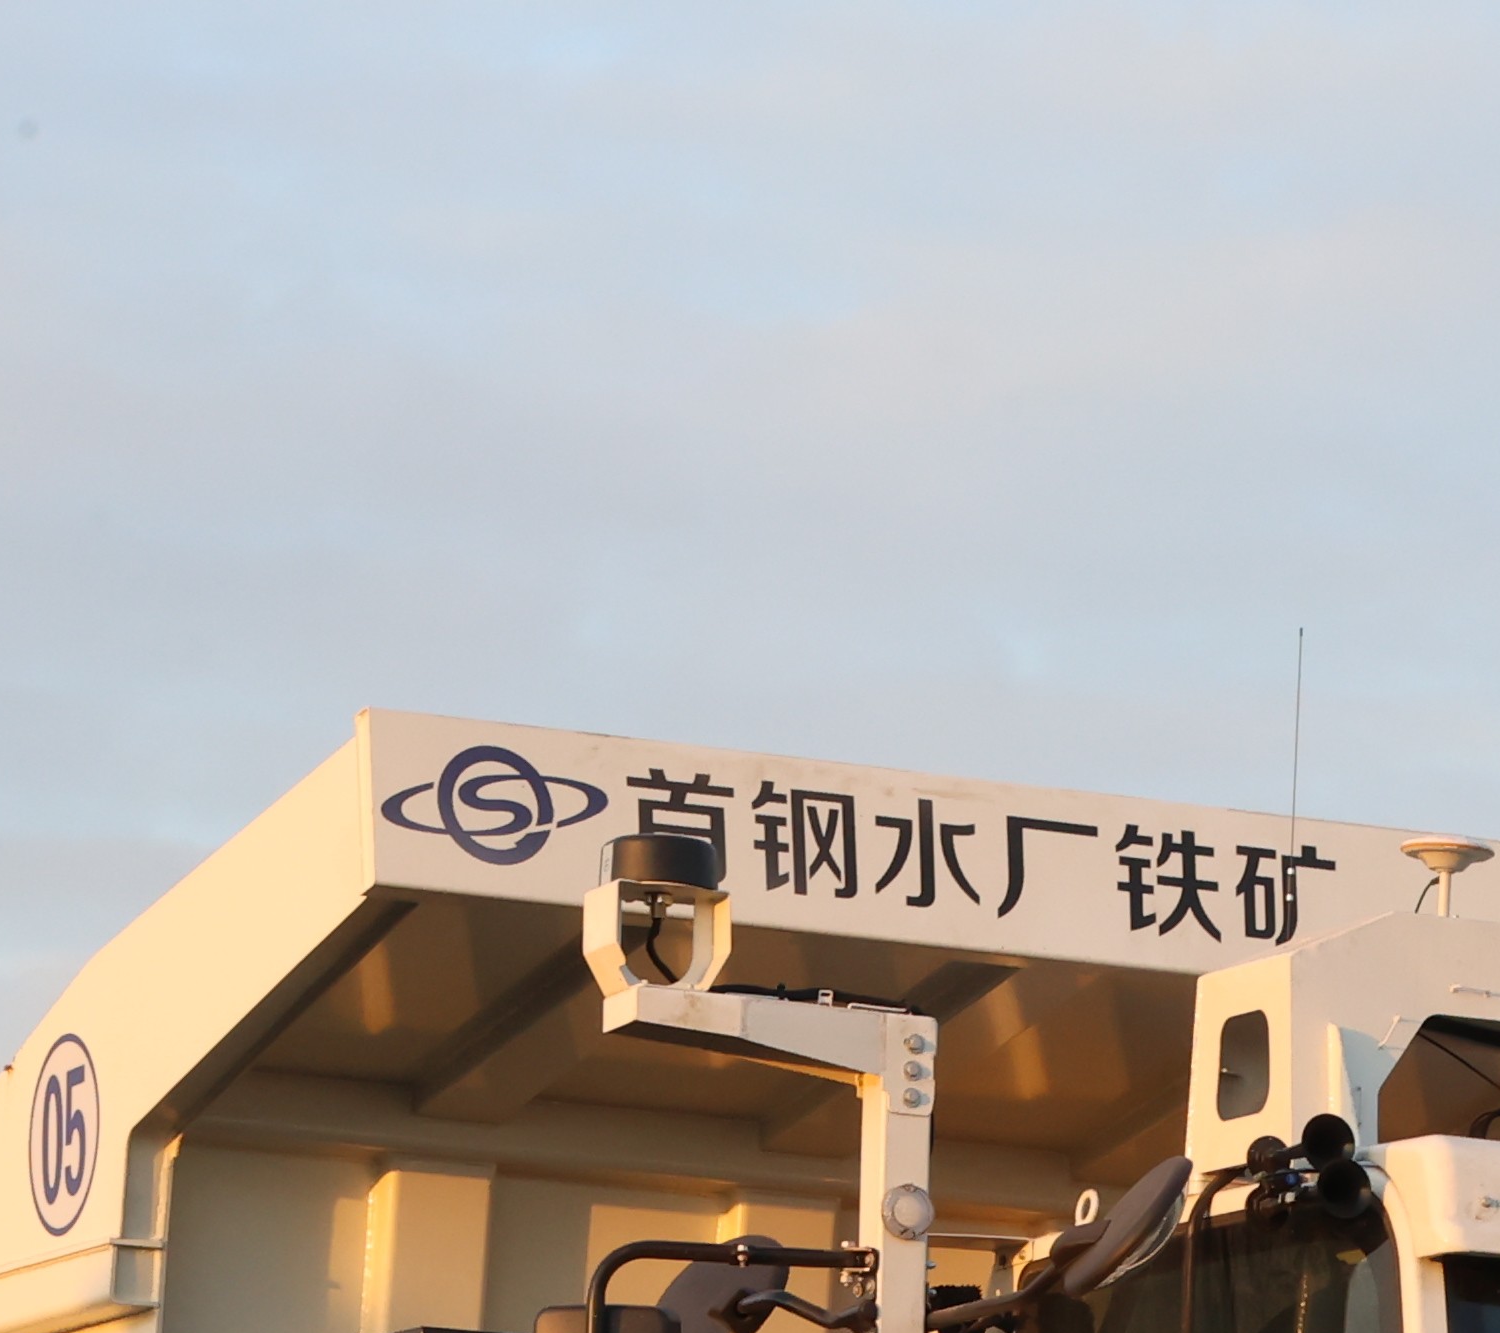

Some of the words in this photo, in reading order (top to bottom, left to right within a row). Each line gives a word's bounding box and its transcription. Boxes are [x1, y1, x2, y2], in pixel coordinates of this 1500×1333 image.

[626, 767, 1336, 945] 首钢水厂铁矿
[42, 1064, 86, 1205] 05
